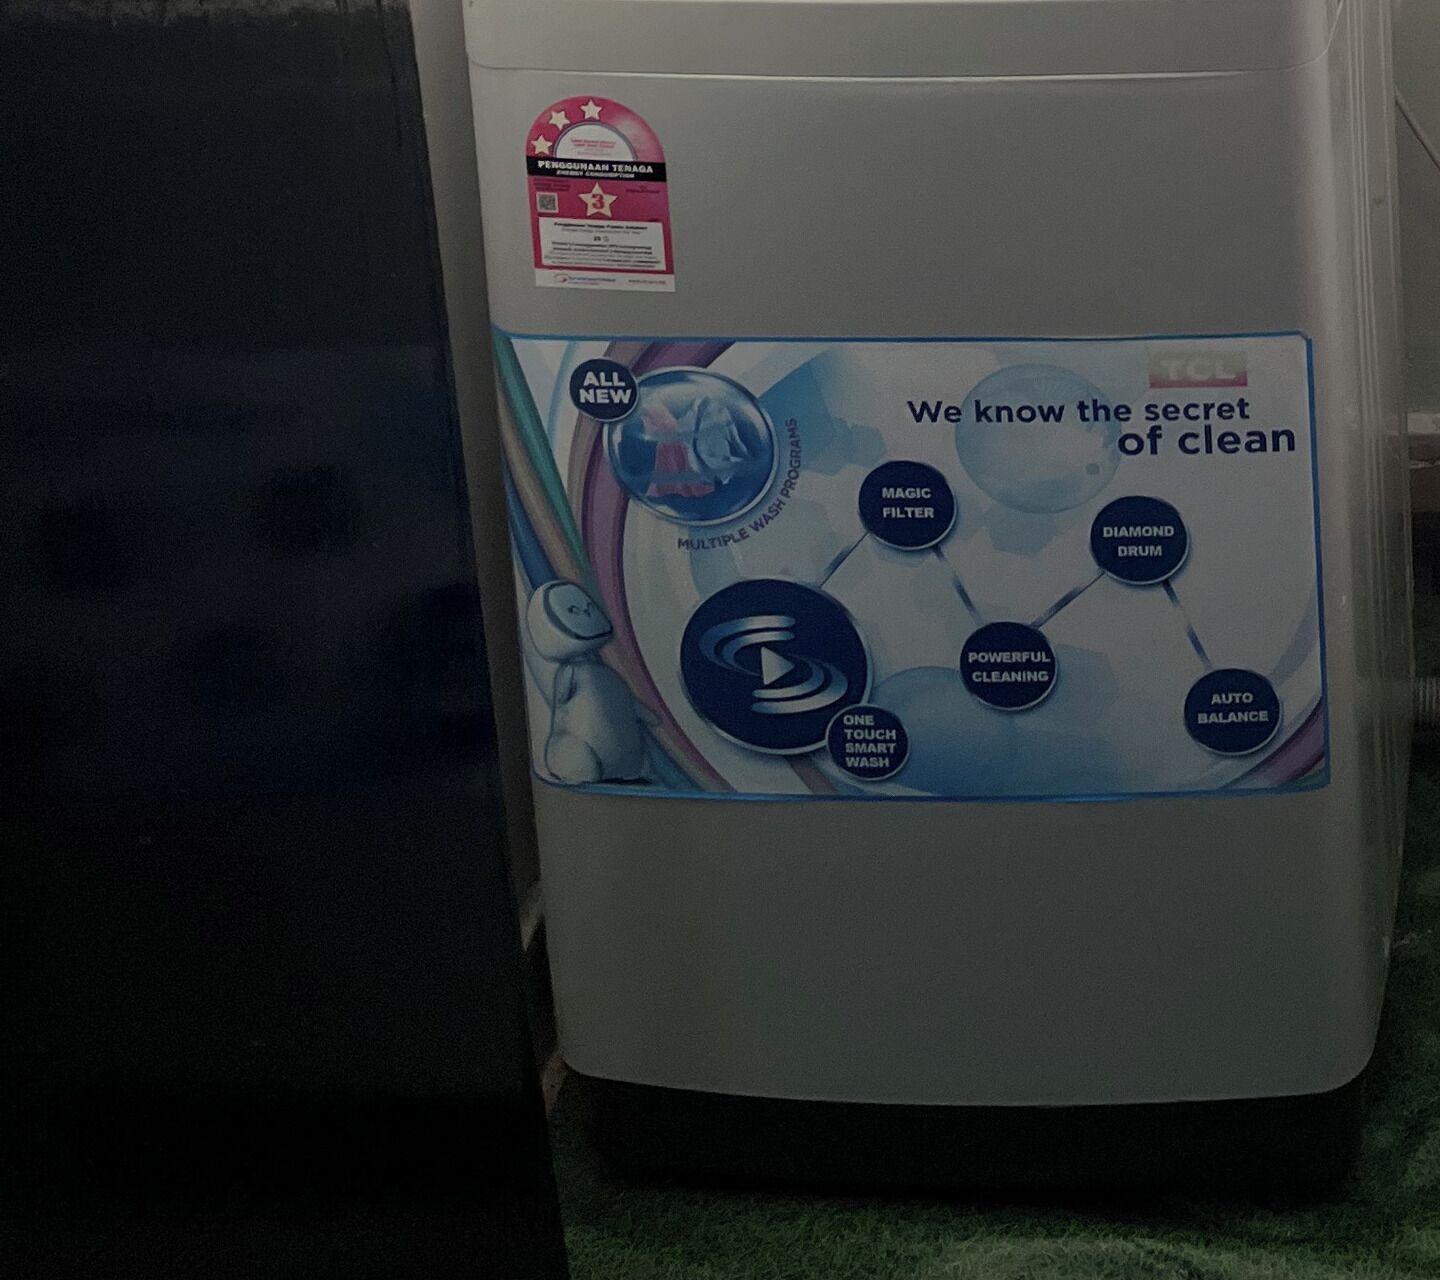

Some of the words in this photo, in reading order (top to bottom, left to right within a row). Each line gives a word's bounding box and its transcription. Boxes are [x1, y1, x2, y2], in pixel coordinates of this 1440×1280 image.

[537, 160, 609, 172] PENGGUNAAN
[612, 164, 654, 174] TENAGA
[591, 193, 605, 209] 3
[1163, 358, 1237, 380] TCL
[583, 372, 626, 387] ALL
[579, 388, 632, 404] NEW
[908, 400, 962, 423] We
[975, 399, 1065, 423] know
[1077, 398, 1132, 422] the
[1145, 398, 1250, 421] secret
[1117, 424, 1163, 456] of
[1178, 424, 1296, 454] clean
[677, 527, 750, 551] MULTIPLE
[749, 498, 785, 534] WASH
[780, 417, 802, 502] PROGRAMS
[882, 487, 932, 499] MAGIC
[882, 506, 934, 519] FILTER
[1102, 525, 1175, 538] DIAMOND
[1117, 545, 1163, 557] DRUM
[967, 651, 1051, 664] POWERFUL
[971, 670, 1049, 683] CLEANING
[1210, 692, 1254, 704] AUTO
[843, 715, 874, 726] ONE
[1197, 710, 1269, 724] BALANCE
[844, 729, 896, 740] TOUCH
[845, 742, 896, 754] SMART
[845, 756, 890, 768] WASH
